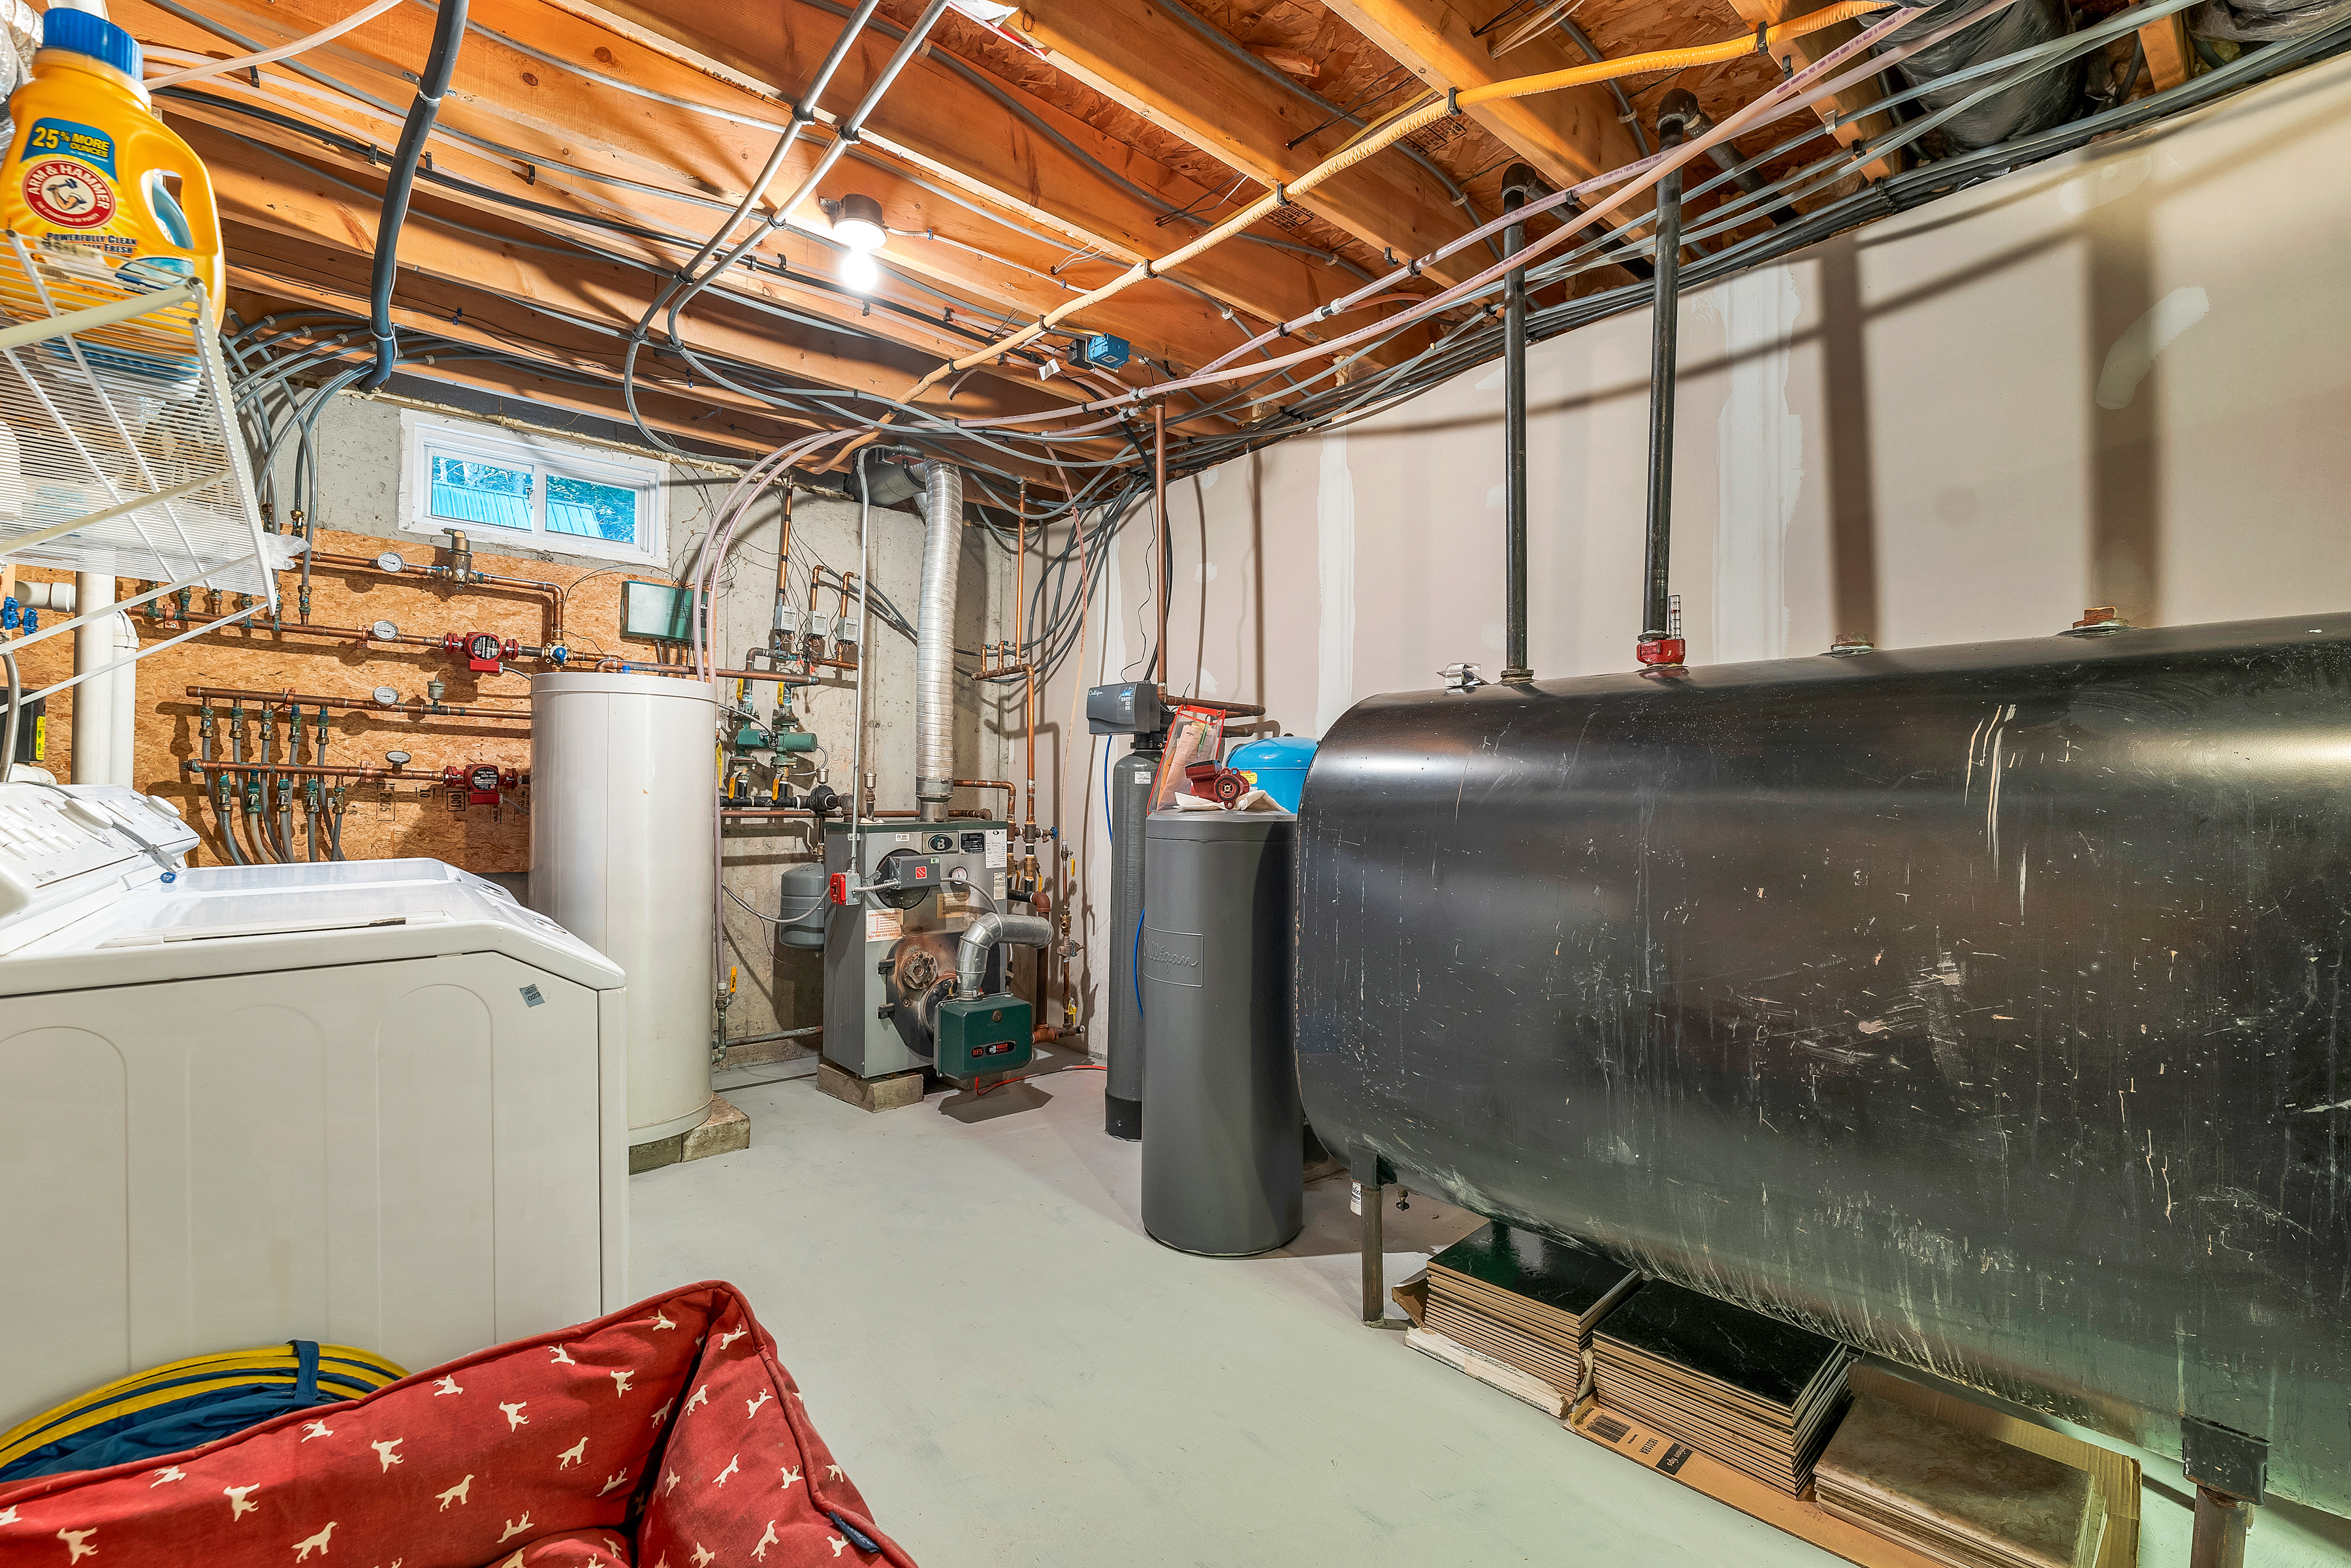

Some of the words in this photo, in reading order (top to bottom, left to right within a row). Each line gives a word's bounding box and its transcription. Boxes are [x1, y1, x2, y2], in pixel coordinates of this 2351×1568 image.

[1878, 18, 1896, 31] POTABLE
[72, 133, 110, 152] MORE
[70, 143, 108, 158] OUNCES
[27, 169, 48, 195] ARM
[44, 165, 59, 175] &
[59, 165, 110, 210] HAMMER
[1279, 209, 1298, 221] TECO
[46, 232, 105, 244] POWERFULLY
[108, 235, 137, 246] CLEAN
[104, 244, 133, 254] FRESH
[451, 794, 462, 808] OCT
[528, 991, 541, 1000] 023
[1639, 1437, 1659, 1455] 183118A
[1667, 1457, 1680, 1467] tips
